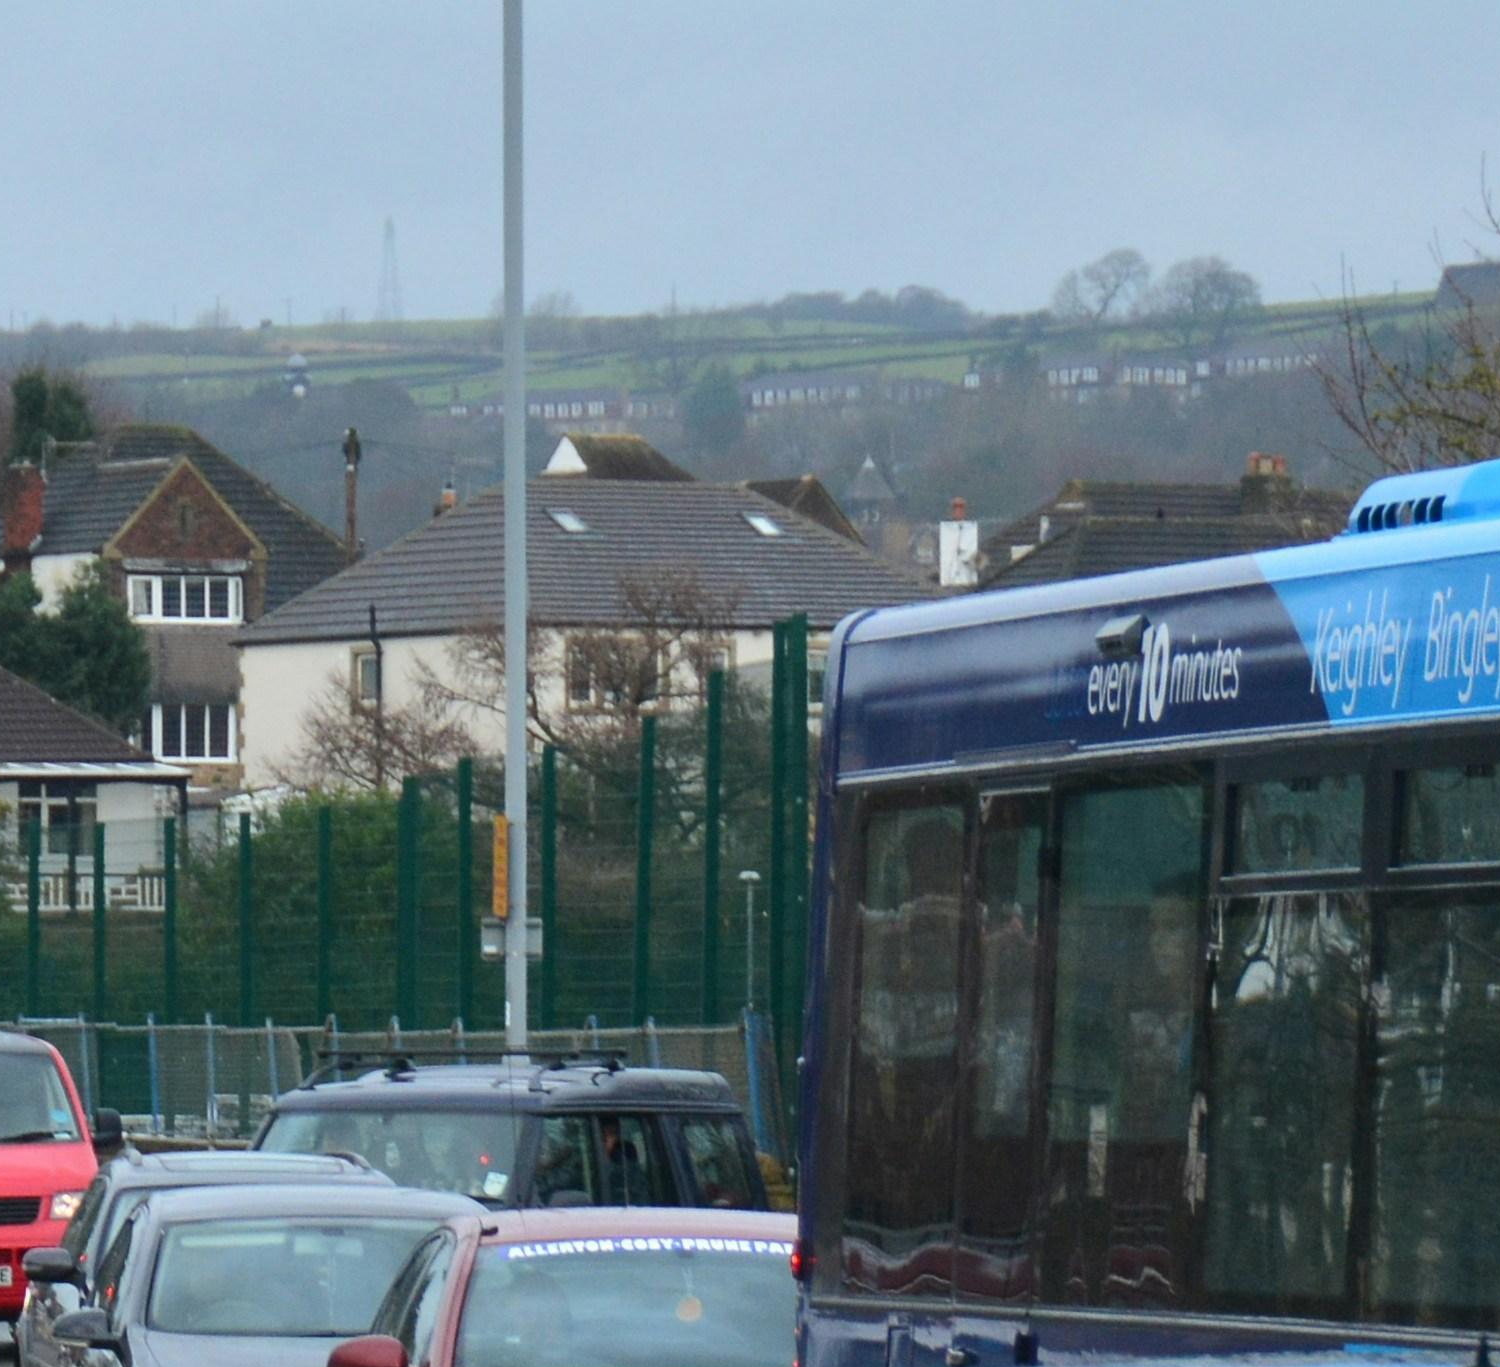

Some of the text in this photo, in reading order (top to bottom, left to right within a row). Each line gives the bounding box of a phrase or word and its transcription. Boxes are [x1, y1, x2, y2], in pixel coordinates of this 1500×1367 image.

[1088, 658, 1138, 728] every
[1138, 622, 1170, 722] 10
[1170, 633, 1242, 704] minutes
[1310, 588, 1412, 716] Keighley
[507, 1239, 614, 1259] ALLERTON
